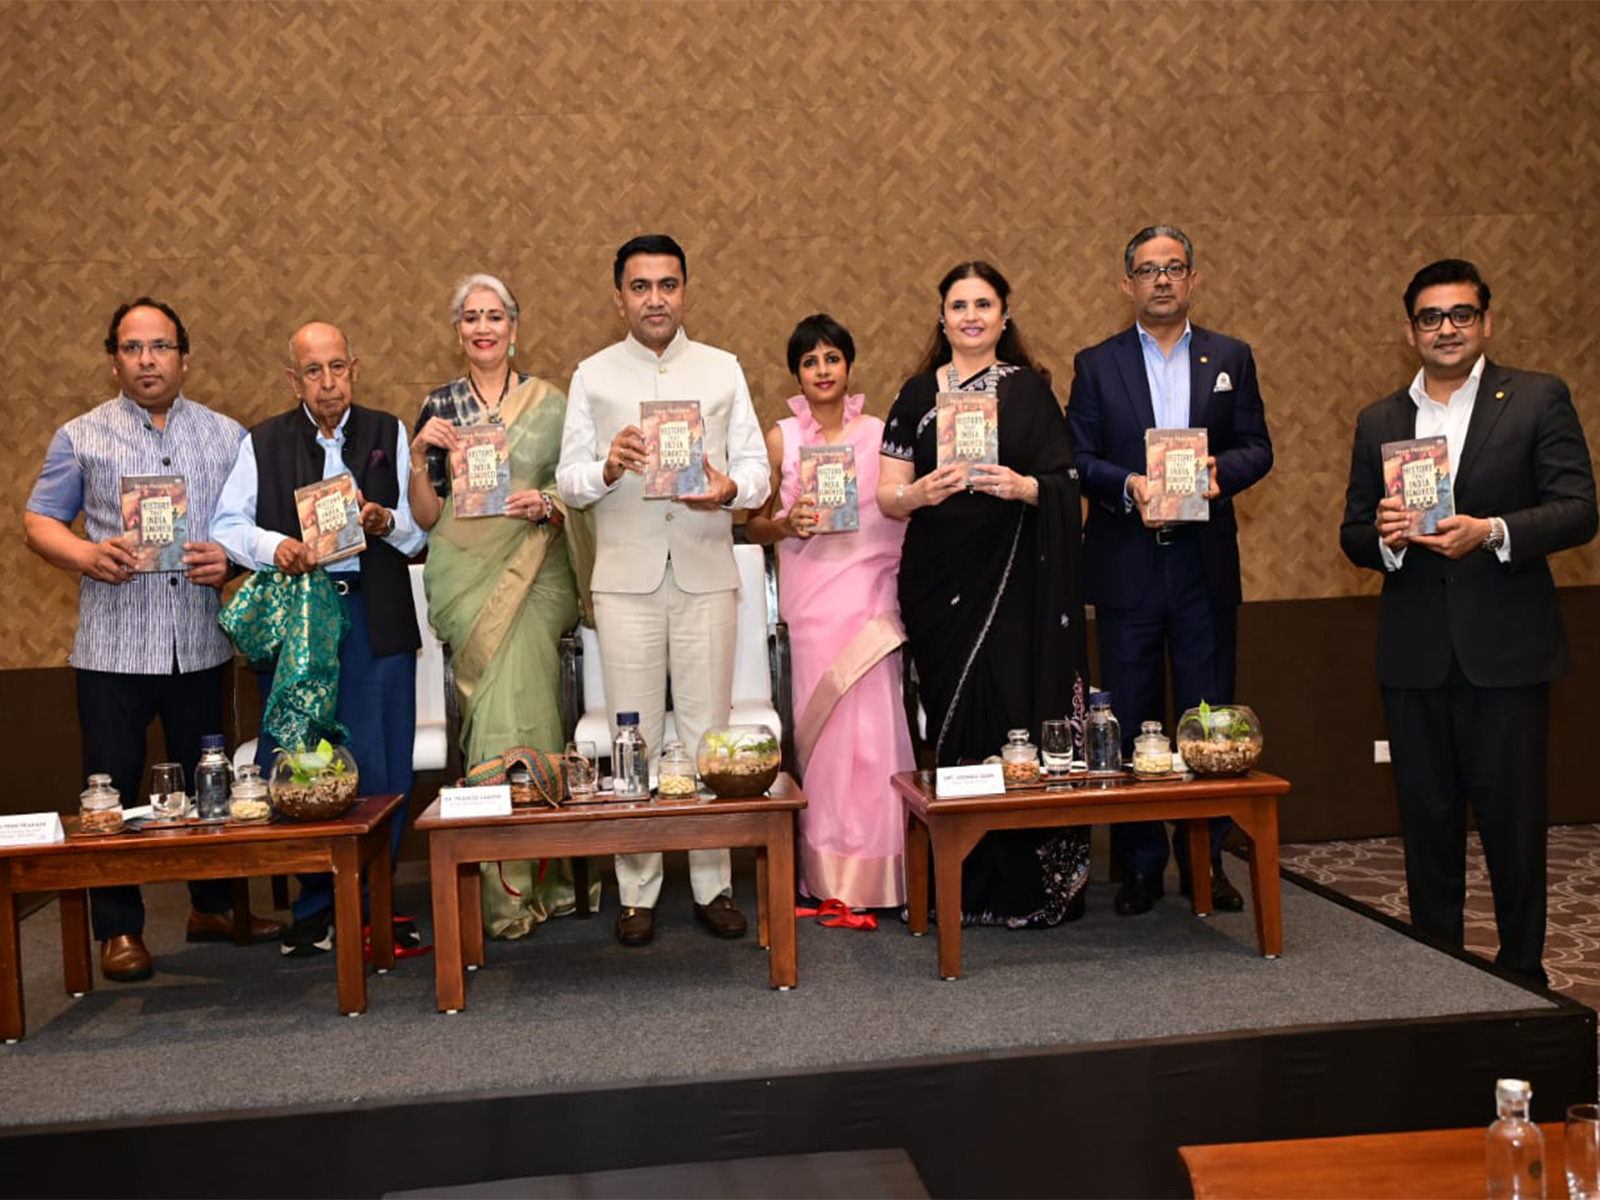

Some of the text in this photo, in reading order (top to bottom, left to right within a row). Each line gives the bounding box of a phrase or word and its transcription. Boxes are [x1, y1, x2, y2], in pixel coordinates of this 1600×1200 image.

[473, 463, 491, 471] INDIA
[1403, 463, 1433, 473] HISTORY
[1170, 468, 1190, 476] INDIA
[1409, 479, 1430, 488] INDIA
[143, 501, 170, 509] HISTORY
[147, 516, 167, 524] INDIA
